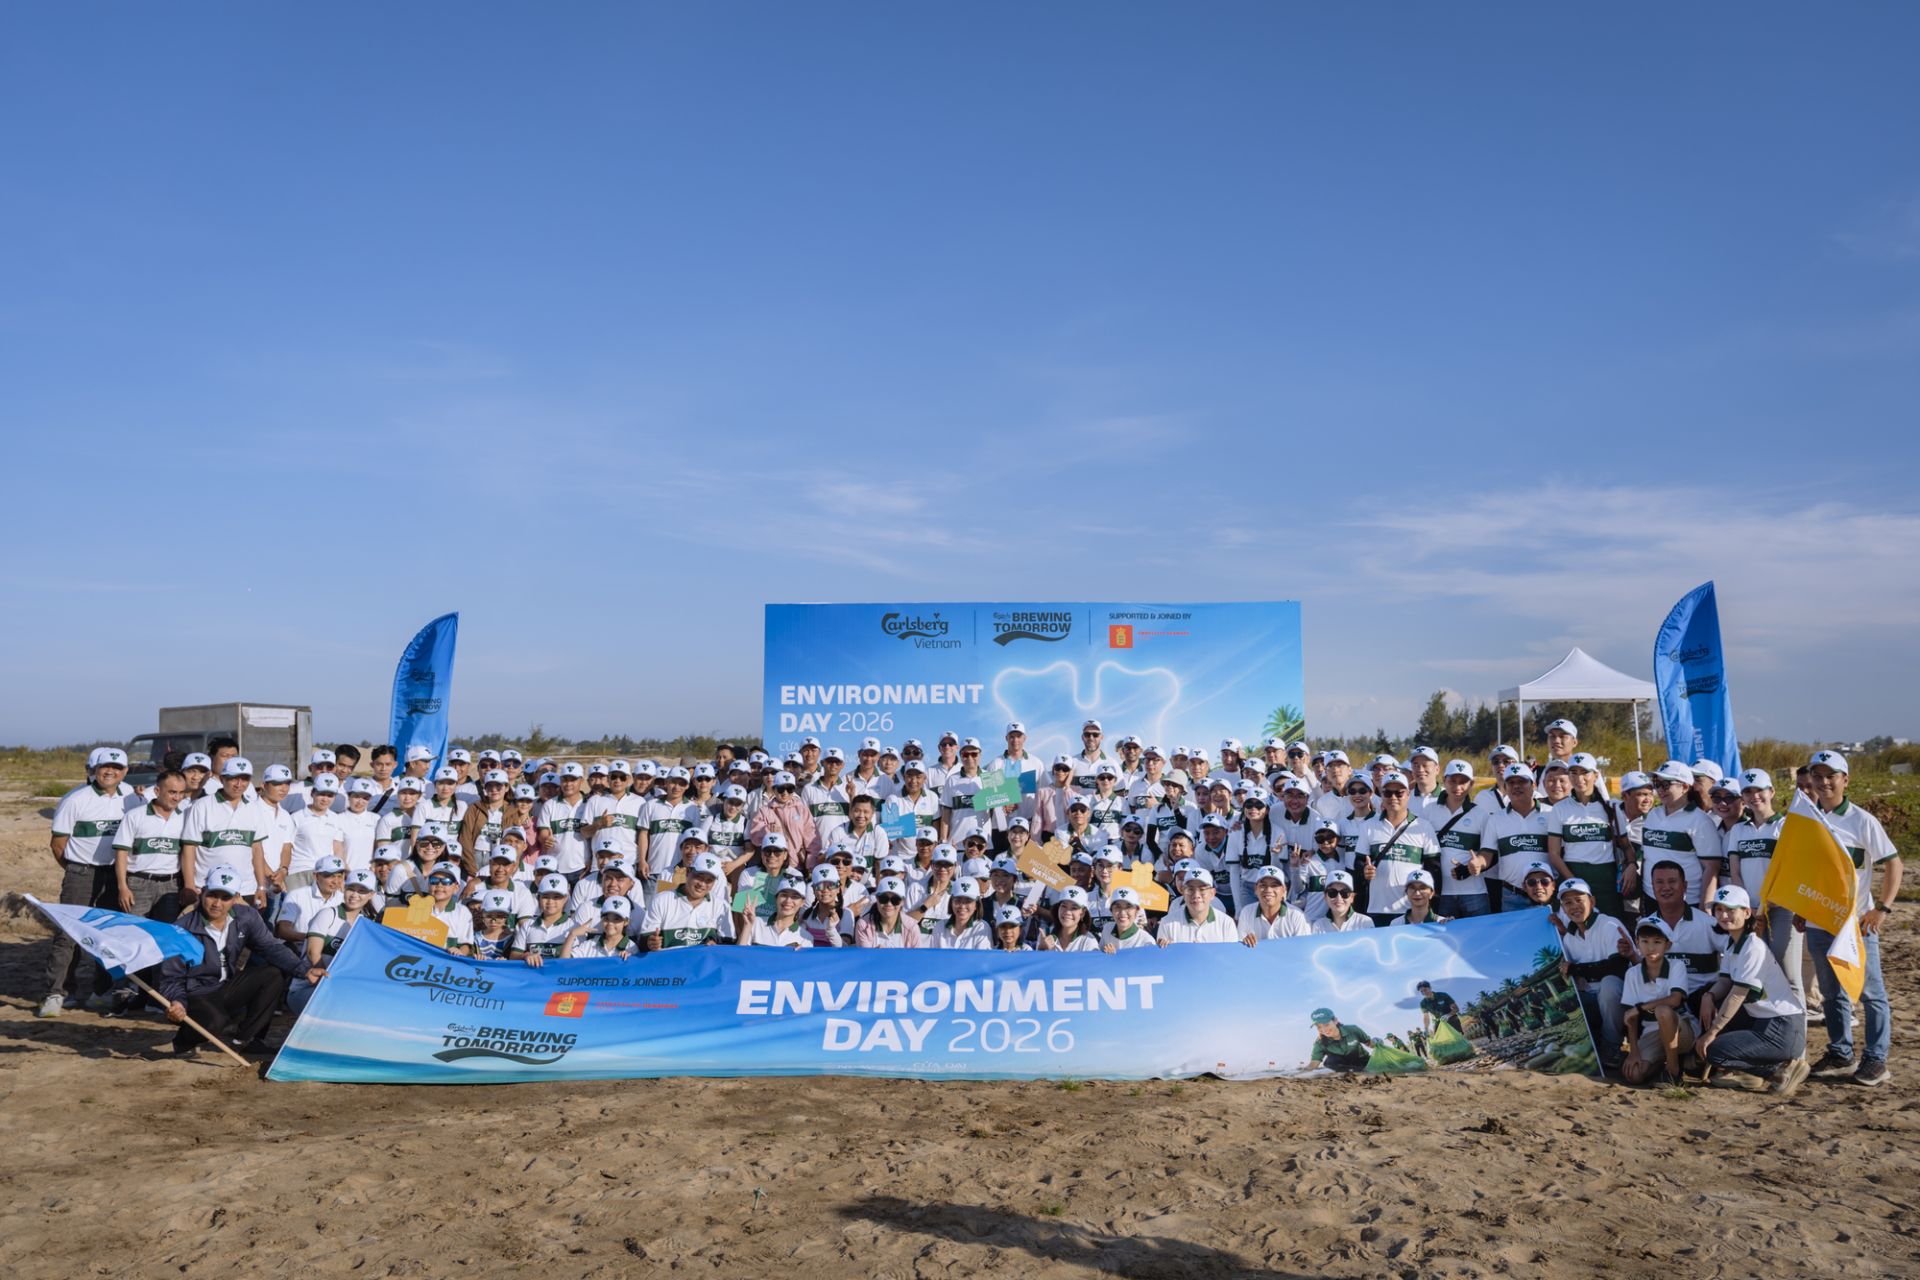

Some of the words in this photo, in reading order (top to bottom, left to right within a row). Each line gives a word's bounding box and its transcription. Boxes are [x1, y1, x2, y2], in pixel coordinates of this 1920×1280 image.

[1012, 612, 1072, 622] BREWING
[1109, 612, 1149, 620] SUPPORTED
[1150, 612, 1157, 620] &
[1158, 612, 1182, 620] JOINED
[1183, 612, 1192, 620] BY
[881, 612, 949, 638] Carlsberg
[993, 622, 1072, 633] TOMORROW
[914, 638, 962, 649] Vietnam
[780, 684, 984, 705] ENVIRONMENT
[779, 712, 833, 733] DAY
[838, 711, 894, 732] 2026
[986, 797, 1009, 806] CARBON
[1570, 825, 1600, 837] Carlsberg
[1644, 831, 1668, 842] Carlsberg
[1510, 836, 1538, 847] Carlsberg
[1739, 841, 1767, 852] Carlsberg
[1031, 867, 1058, 885] NATURE
[1798, 884, 1848, 917] EMPOWE
[674, 929, 702, 940] Carlsberg
[384, 955, 495, 994] Carlsberg
[557, 977, 619, 987] SUPPORTED
[621, 978, 631, 986] &
[632, 977, 670, 986] JOINED
[672, 977, 687, 986] BY
[429, 988, 505, 1011] Vietnam
[736, 975, 1165, 1015] ENVIRONMENT
[447, 1022, 477, 1034] Carlsberg
[477, 1026, 578, 1045] BREWING
[822, 1018, 939, 1052] DAY
[948, 1018, 1075, 1053] 2026
[441, 1035, 573, 1054] TOMORROW
